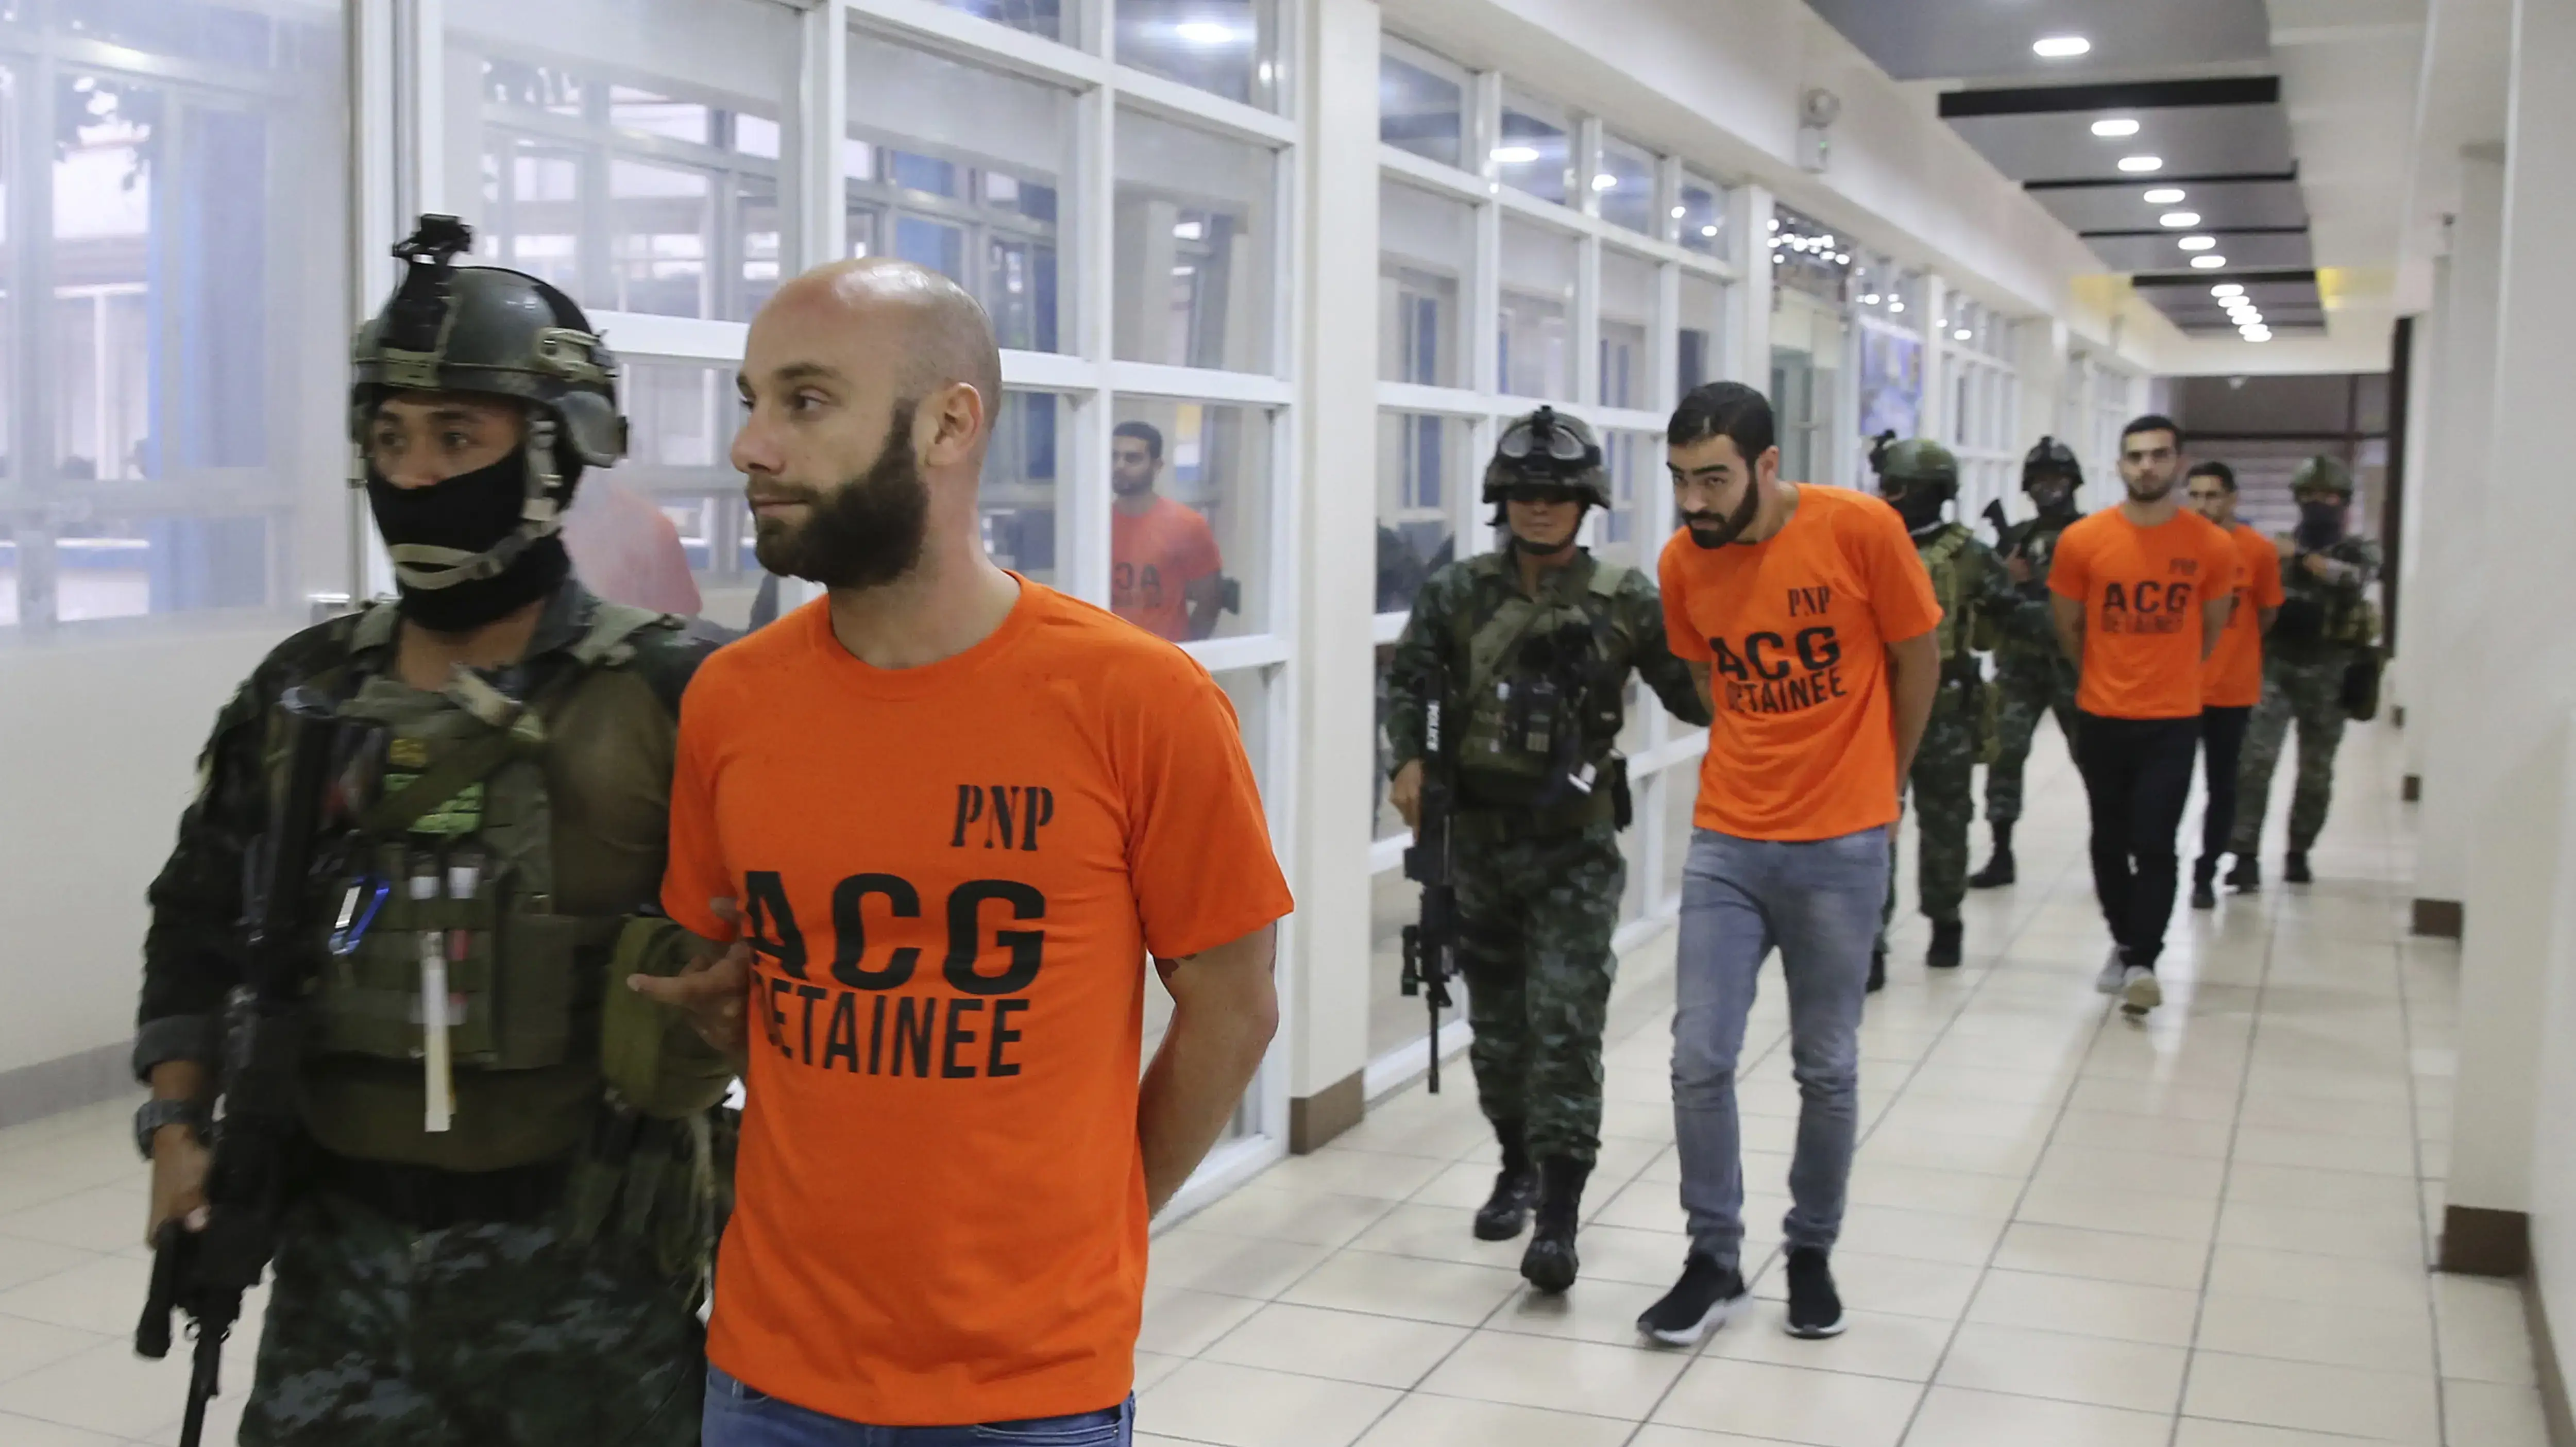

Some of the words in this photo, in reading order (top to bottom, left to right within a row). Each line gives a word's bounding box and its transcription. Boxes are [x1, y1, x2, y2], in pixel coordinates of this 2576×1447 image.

[1788, 586, 1830, 616] PNP
[2104, 581, 2192, 613] ACG
[1709, 627, 1841, 680] ACG
[951, 784, 1054, 851] PNP
[745, 871, 1045, 995] ACG
